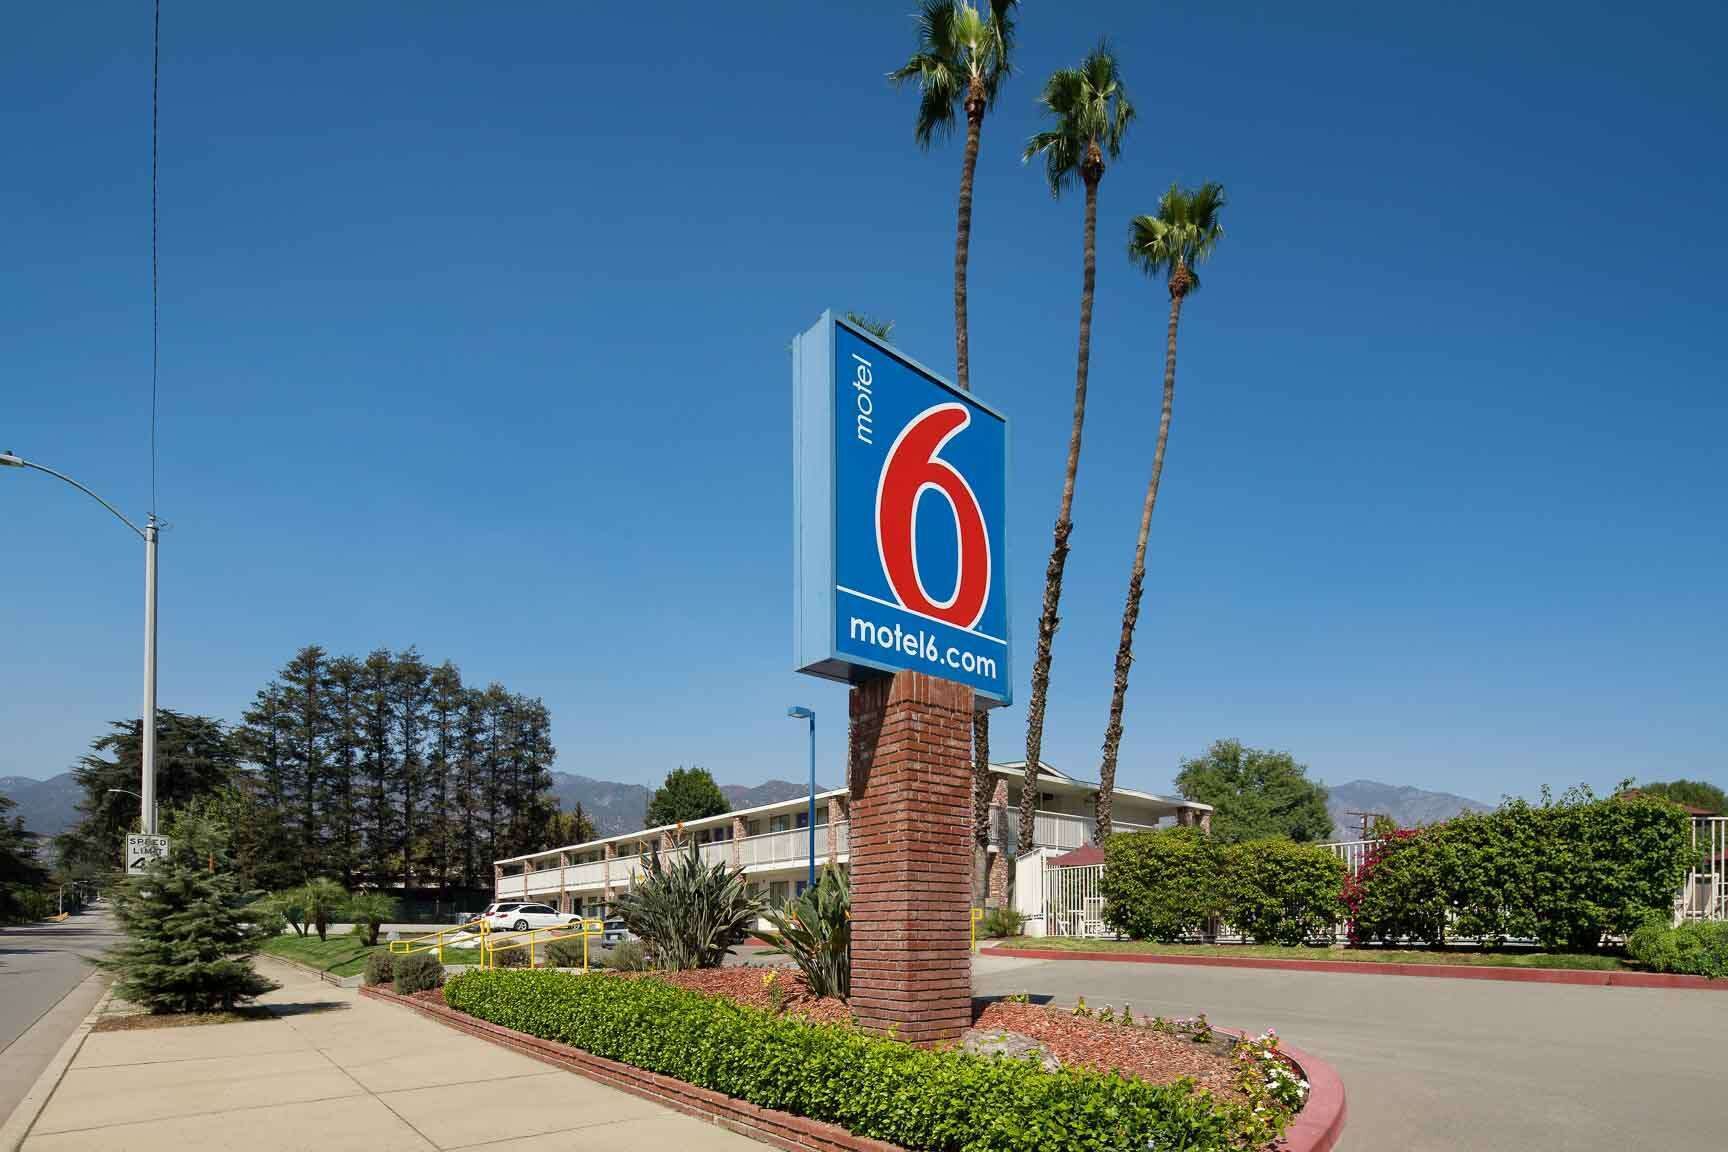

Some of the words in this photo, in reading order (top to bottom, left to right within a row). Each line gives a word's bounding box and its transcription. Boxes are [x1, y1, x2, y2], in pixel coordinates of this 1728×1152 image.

[852, 353, 872, 444] motel
[875, 402, 991, 632] 6
[850, 616, 997, 679] motel6.com
[129, 838, 167, 846] SPEED
[133, 847, 163, 855] LIMIT
